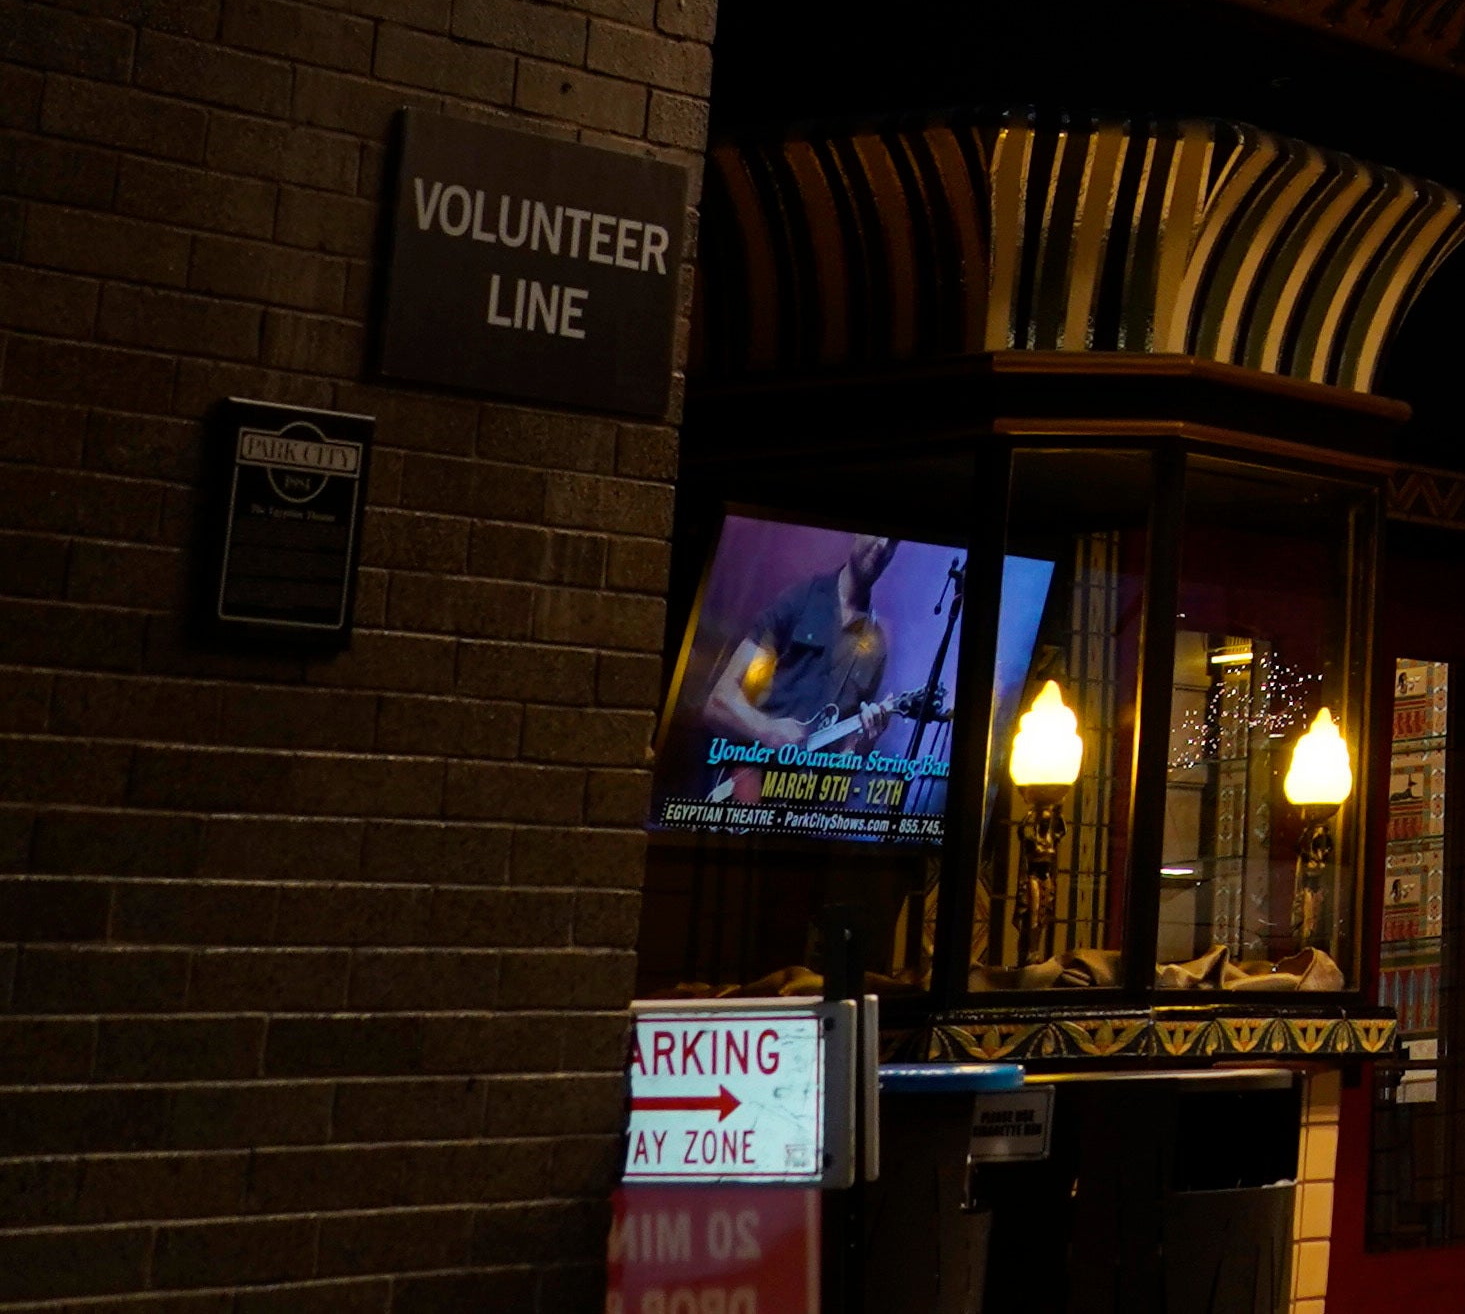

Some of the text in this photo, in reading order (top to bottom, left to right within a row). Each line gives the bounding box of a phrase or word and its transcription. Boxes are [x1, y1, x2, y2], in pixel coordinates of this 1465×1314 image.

[414, 177, 670, 276] VOLUNTEER
[487, 274, 589, 340] LINE
[247, 437, 349, 468] PARK CITY
[707, 737, 775, 765] Yonder
[778, 743, 863, 770] Mountain
[865, 750, 920, 781] String
[761, 771, 818, 801] MARCH
[819, 774, 851, 802] 9TH
[866, 778, 905, 805] 12TH
[665, 804, 944, 835] EGYPTIAN THEATRE ParkCityShows.com 855.745.
[683, 1129, 756, 1165] ZONE
